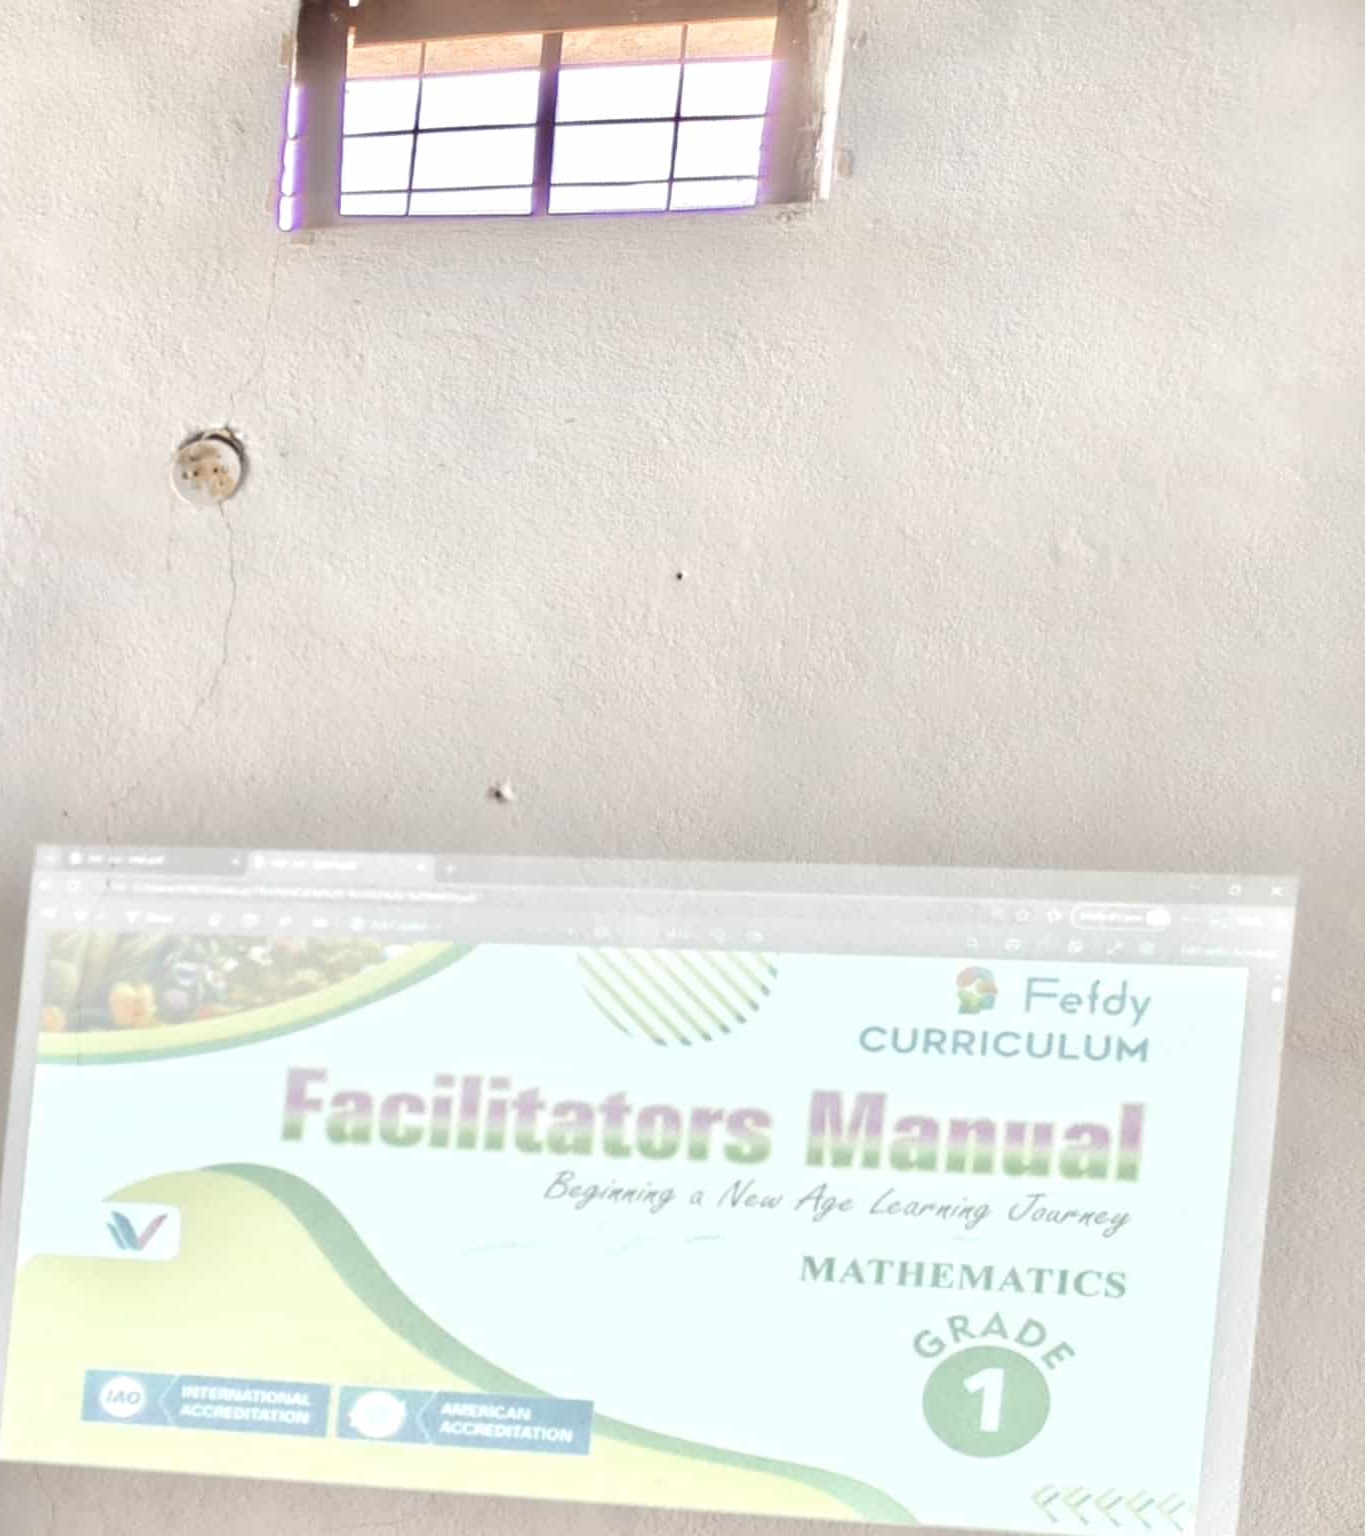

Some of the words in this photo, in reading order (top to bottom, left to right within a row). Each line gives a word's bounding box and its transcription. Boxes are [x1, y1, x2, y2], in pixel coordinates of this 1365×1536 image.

[859, 1026, 1150, 1063] CURRICULUM
[280, 1066, 774, 1165] Facilitators
[804, 1088, 1146, 1182] Manual
[543, 1170, 676, 1213] Beginning
[689, 1189, 704, 1206] a
[717, 1179, 784, 1209] New
[794, 1182, 854, 1222] Age
[869, 1187, 991, 1230] Learning
[1006, 1193, 1131, 1238] Journey
[800, 1255, 1127, 1299] MATHEMATICS
[912, 1311, 1076, 1371] GRADE
[105, 1389, 141, 1405] IAO
[181, 1385, 312, 1406] INTERNATIONAL
[440, 1402, 532, 1421] AMERICAN
[963, 1367, 1005, 1433] 1
[180, 1404, 310, 1425] ACCREDITATION
[439, 1420, 573, 1443] ACCREDITATION
